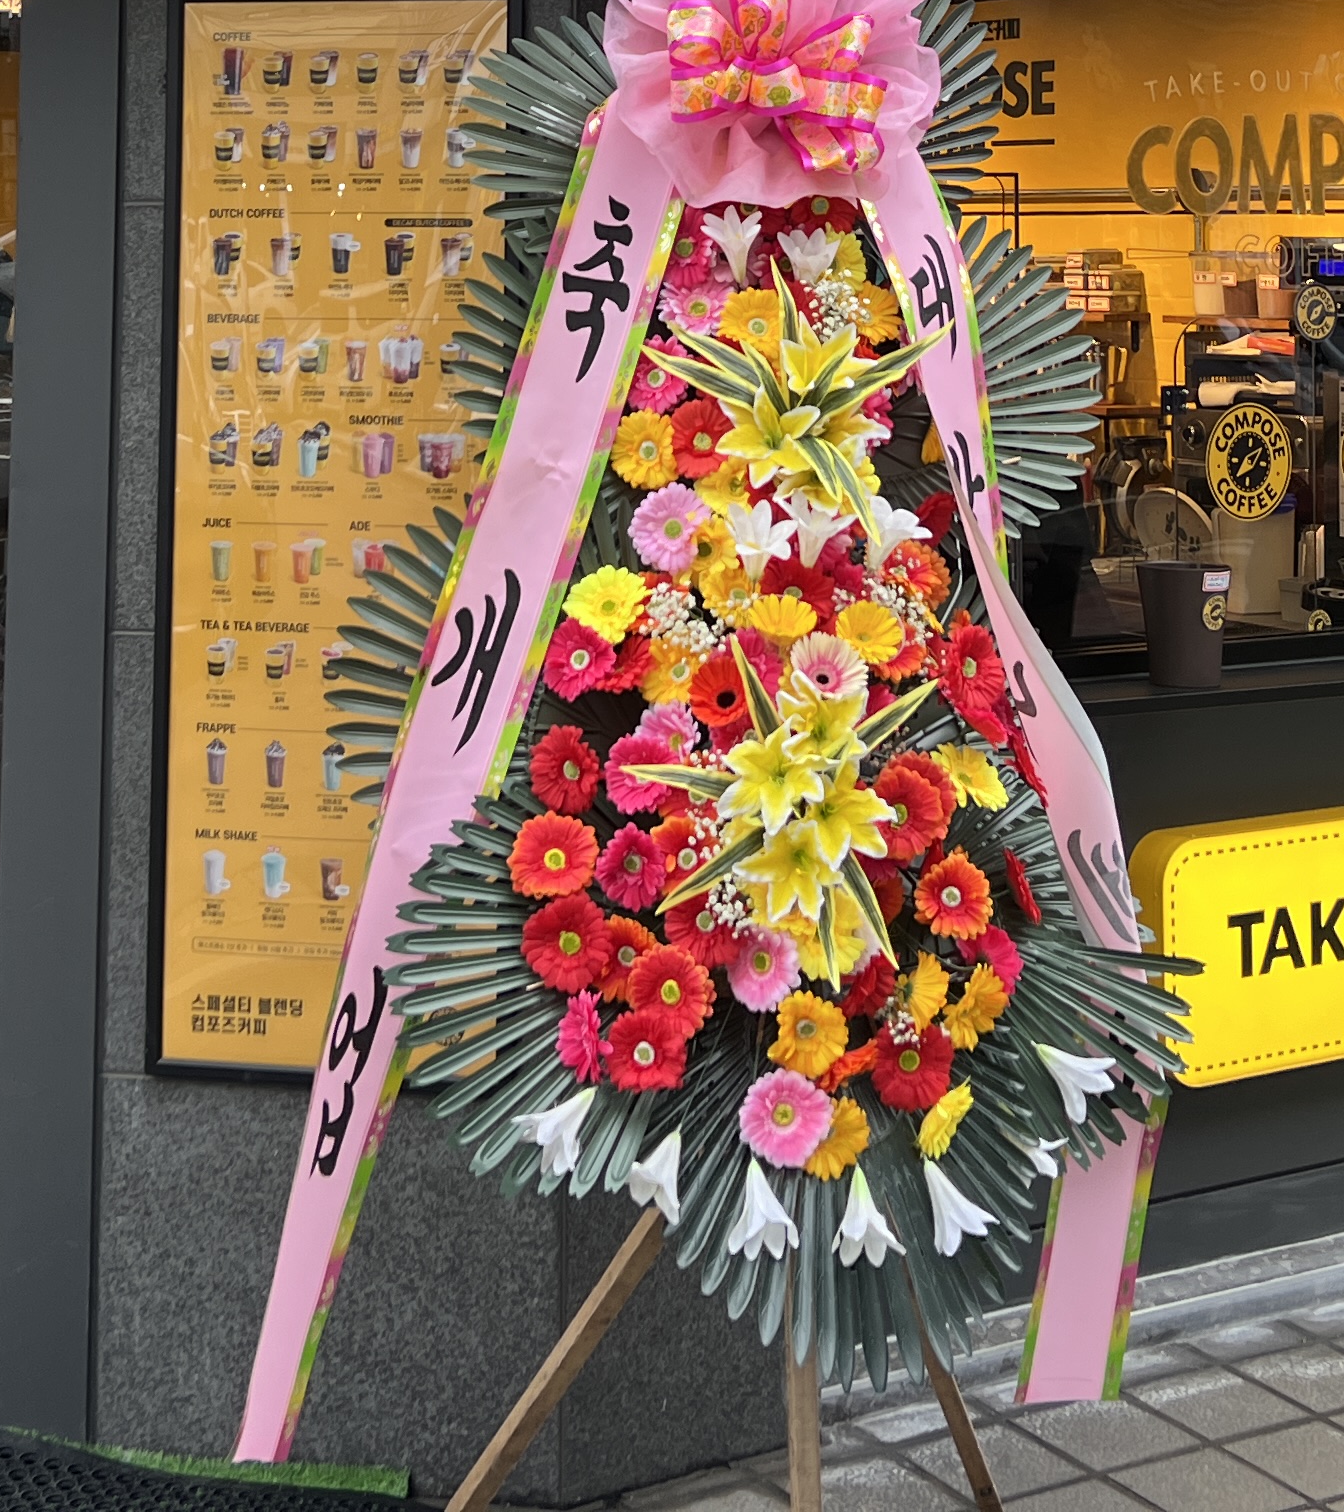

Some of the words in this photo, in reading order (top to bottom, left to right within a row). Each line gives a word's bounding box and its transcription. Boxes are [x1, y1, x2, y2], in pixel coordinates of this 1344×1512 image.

[213, 32, 252, 42] COFFEE
[1144, 69, 1313, 102] TAKE-OUT
[209, 208, 244, 219] DUTCH
[247, 208, 286, 219] COFFEE
[1299, 285, 1334, 311] COMPOSE
[207, 313, 261, 325] BEVERAGE
[1301, 320, 1332, 339] COFFEE
[349, 414, 405, 426] SMOOTHIE
[1215, 411, 1286, 461] COMPOSE
[1217, 477, 1278, 514] COFFEE
[202, 518, 233, 530] JUICE
[349, 520, 372, 532] ADE
[200, 620, 221, 632] TEA
[223, 620, 231, 632] &
[233, 621, 254, 632] TEA
[256, 621, 311, 634] BEVERAGE
[196, 722, 238, 734] FRAPPE
[195, 828, 221, 840] MILK
[223, 829, 259, 842] SHAKE
[191, 993, 253, 1015] 스페셜티
[257, 994, 305, 1017] 블렌딩
[190, 1014, 269, 1037] 컴포즈커피
